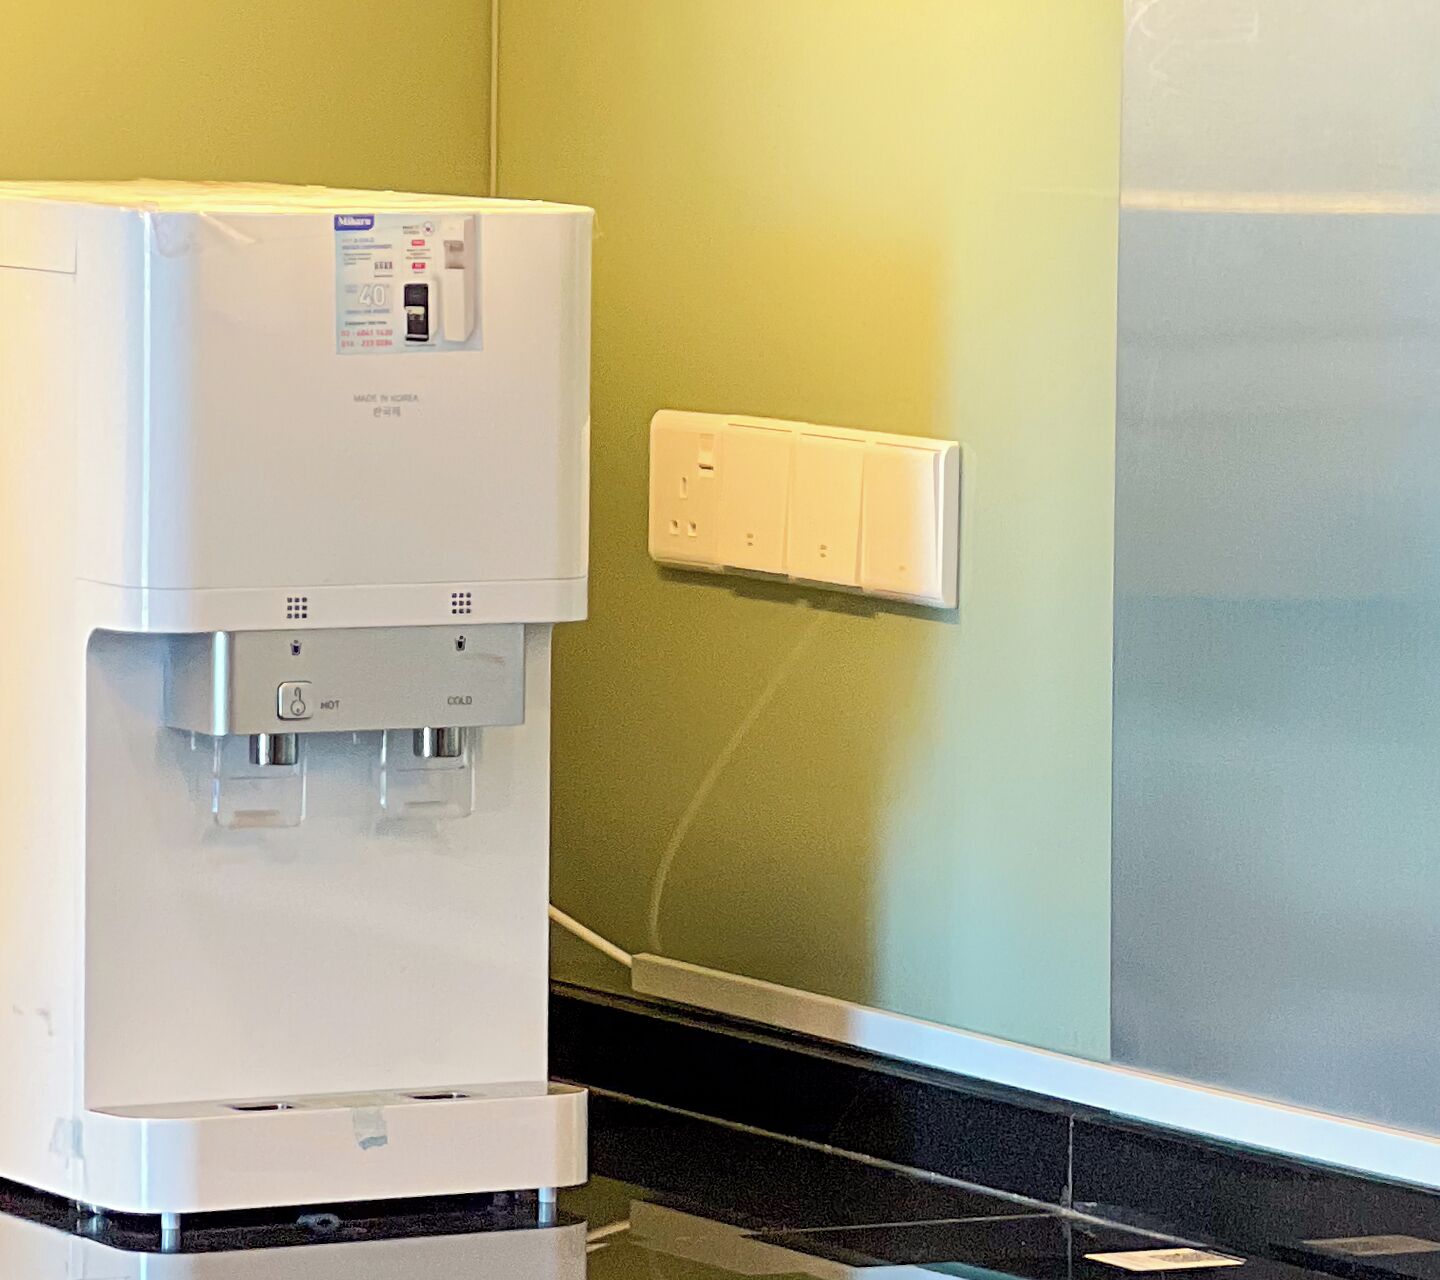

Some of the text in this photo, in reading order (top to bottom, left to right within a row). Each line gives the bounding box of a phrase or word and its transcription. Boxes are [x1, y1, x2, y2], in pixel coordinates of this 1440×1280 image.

[353, 392, 419, 402] MADE IN KOREA
[320, 699, 340, 710] HOT
[447, 695, 473, 705] COLD
